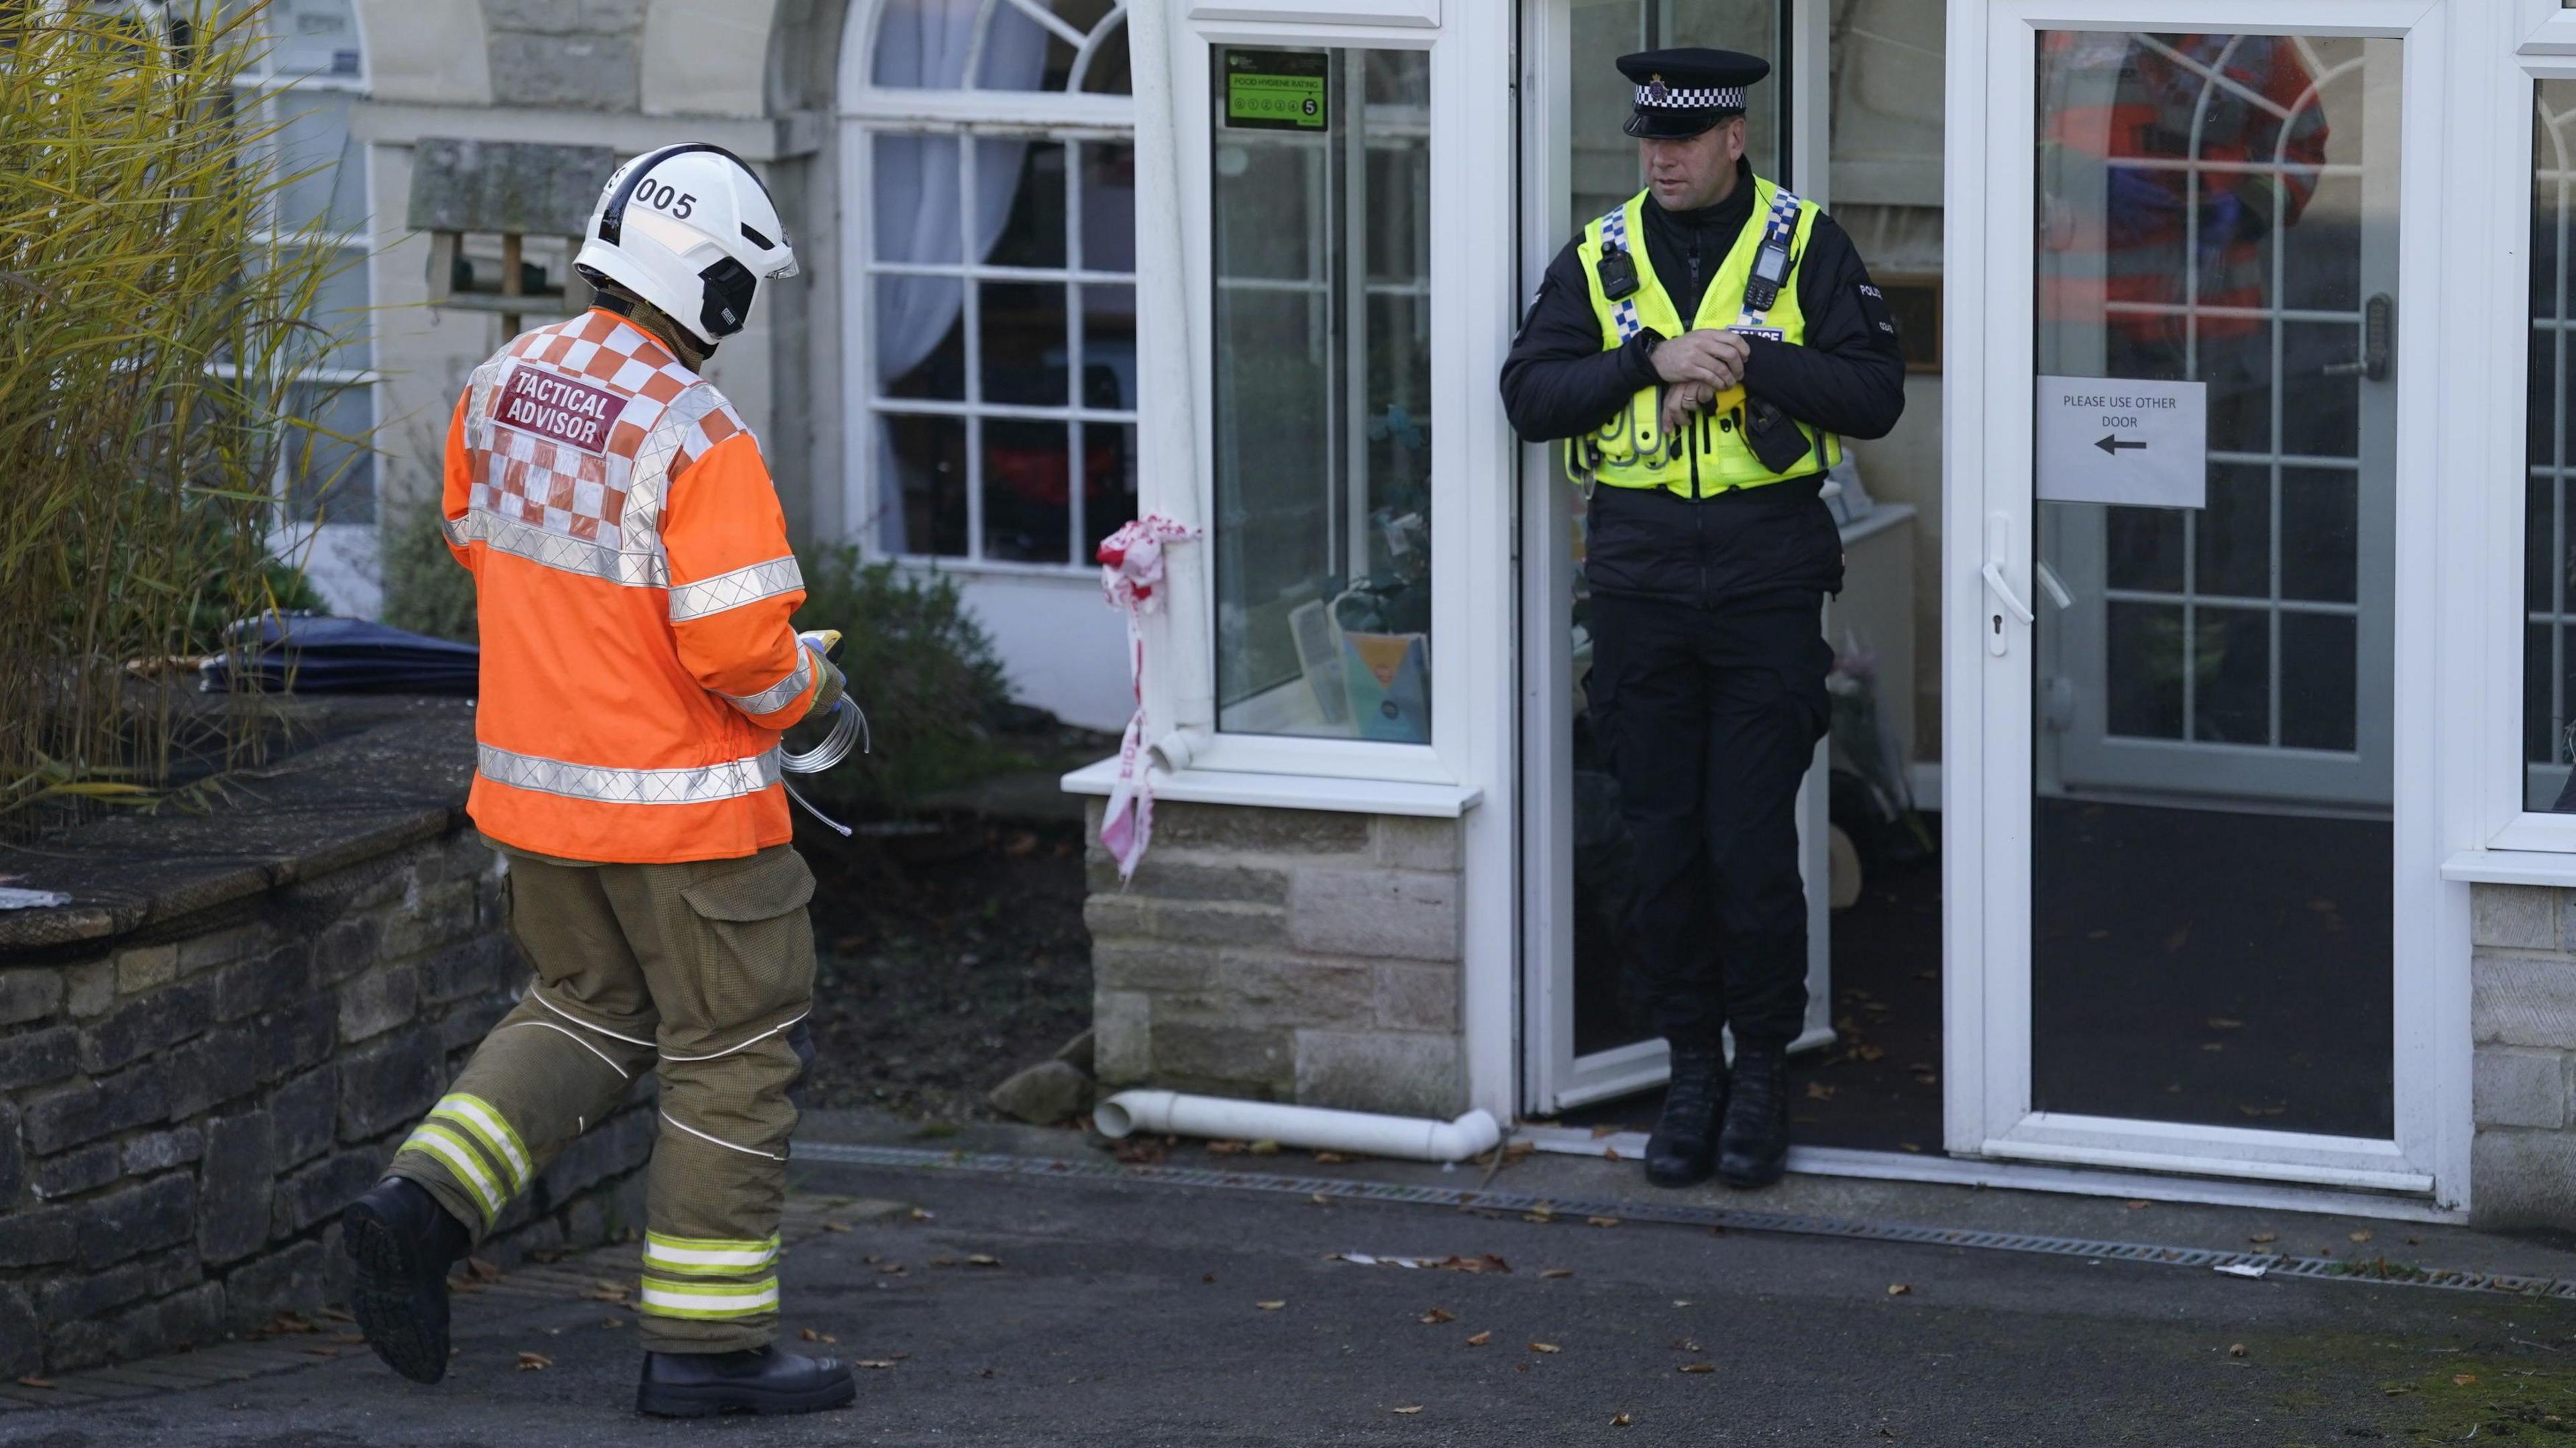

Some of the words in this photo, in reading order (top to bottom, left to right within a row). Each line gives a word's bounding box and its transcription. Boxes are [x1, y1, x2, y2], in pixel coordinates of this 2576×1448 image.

[1234, 77, 1257, 85] FOOD
[1258, 78, 1290, 87] HYGIENE
[1292, 80, 1319, 89] RATING
[1305, 101, 1315, 114] 5
[635, 178, 697, 220] 005
[1859, 284, 1883, 300] POLIC
[515, 371, 608, 420] TACTICAL
[2063, 395, 2106, 408] PLEASE
[2109, 396, 2132, 408] USE
[2135, 397, 2176, 409] OTHER
[506, 398, 597, 444] ADVISOR
[2102, 416, 2138, 428] DOOR
